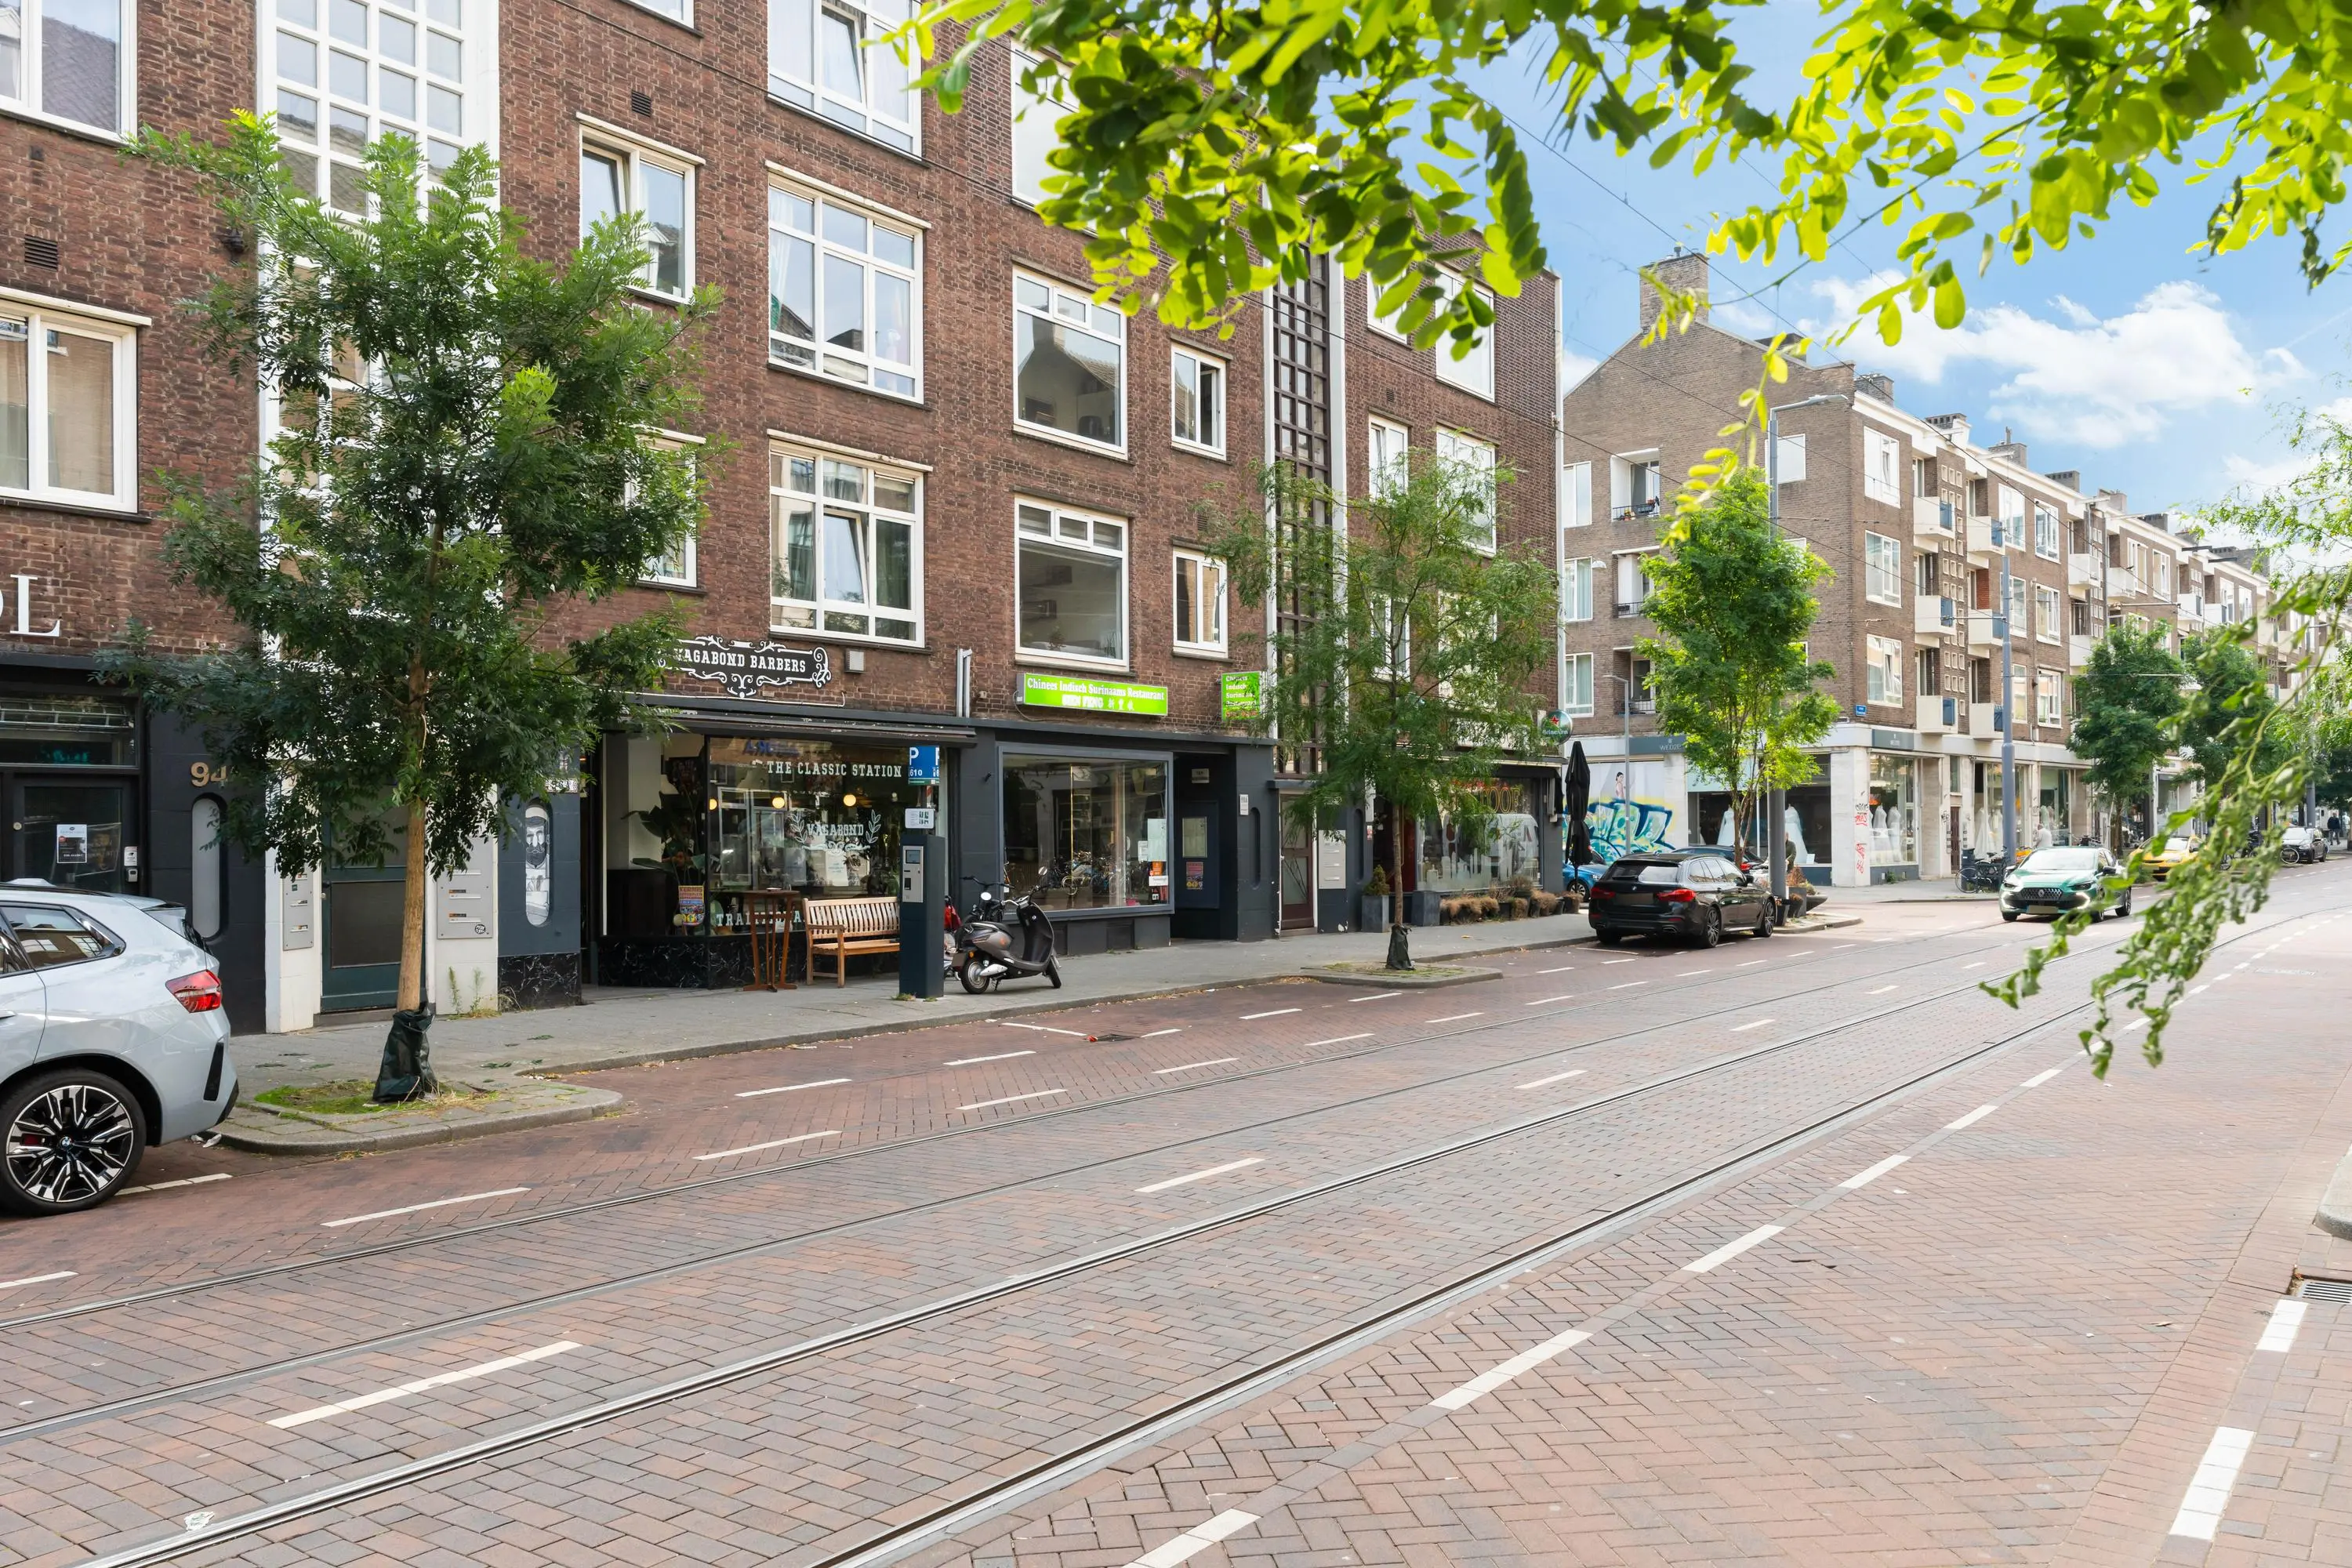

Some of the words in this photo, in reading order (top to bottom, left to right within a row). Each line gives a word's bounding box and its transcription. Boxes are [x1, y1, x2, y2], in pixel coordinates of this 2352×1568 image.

[0, 574, 60, 637] L
[750, 655, 806, 673] BARBERS
[1027, 677, 1058, 691] Chinees
[1059, 681, 1087, 693] Indisch
[1088, 684, 1126, 697] Surinaams
[1127, 687, 1164, 700] Restaurant
[909, 746, 920, 766] P
[767, 761, 792, 774] THE
[797, 762, 847, 775] CLASSIC
[852, 764, 902, 778] STATION
[807, 823, 864, 837] VAGABOND
